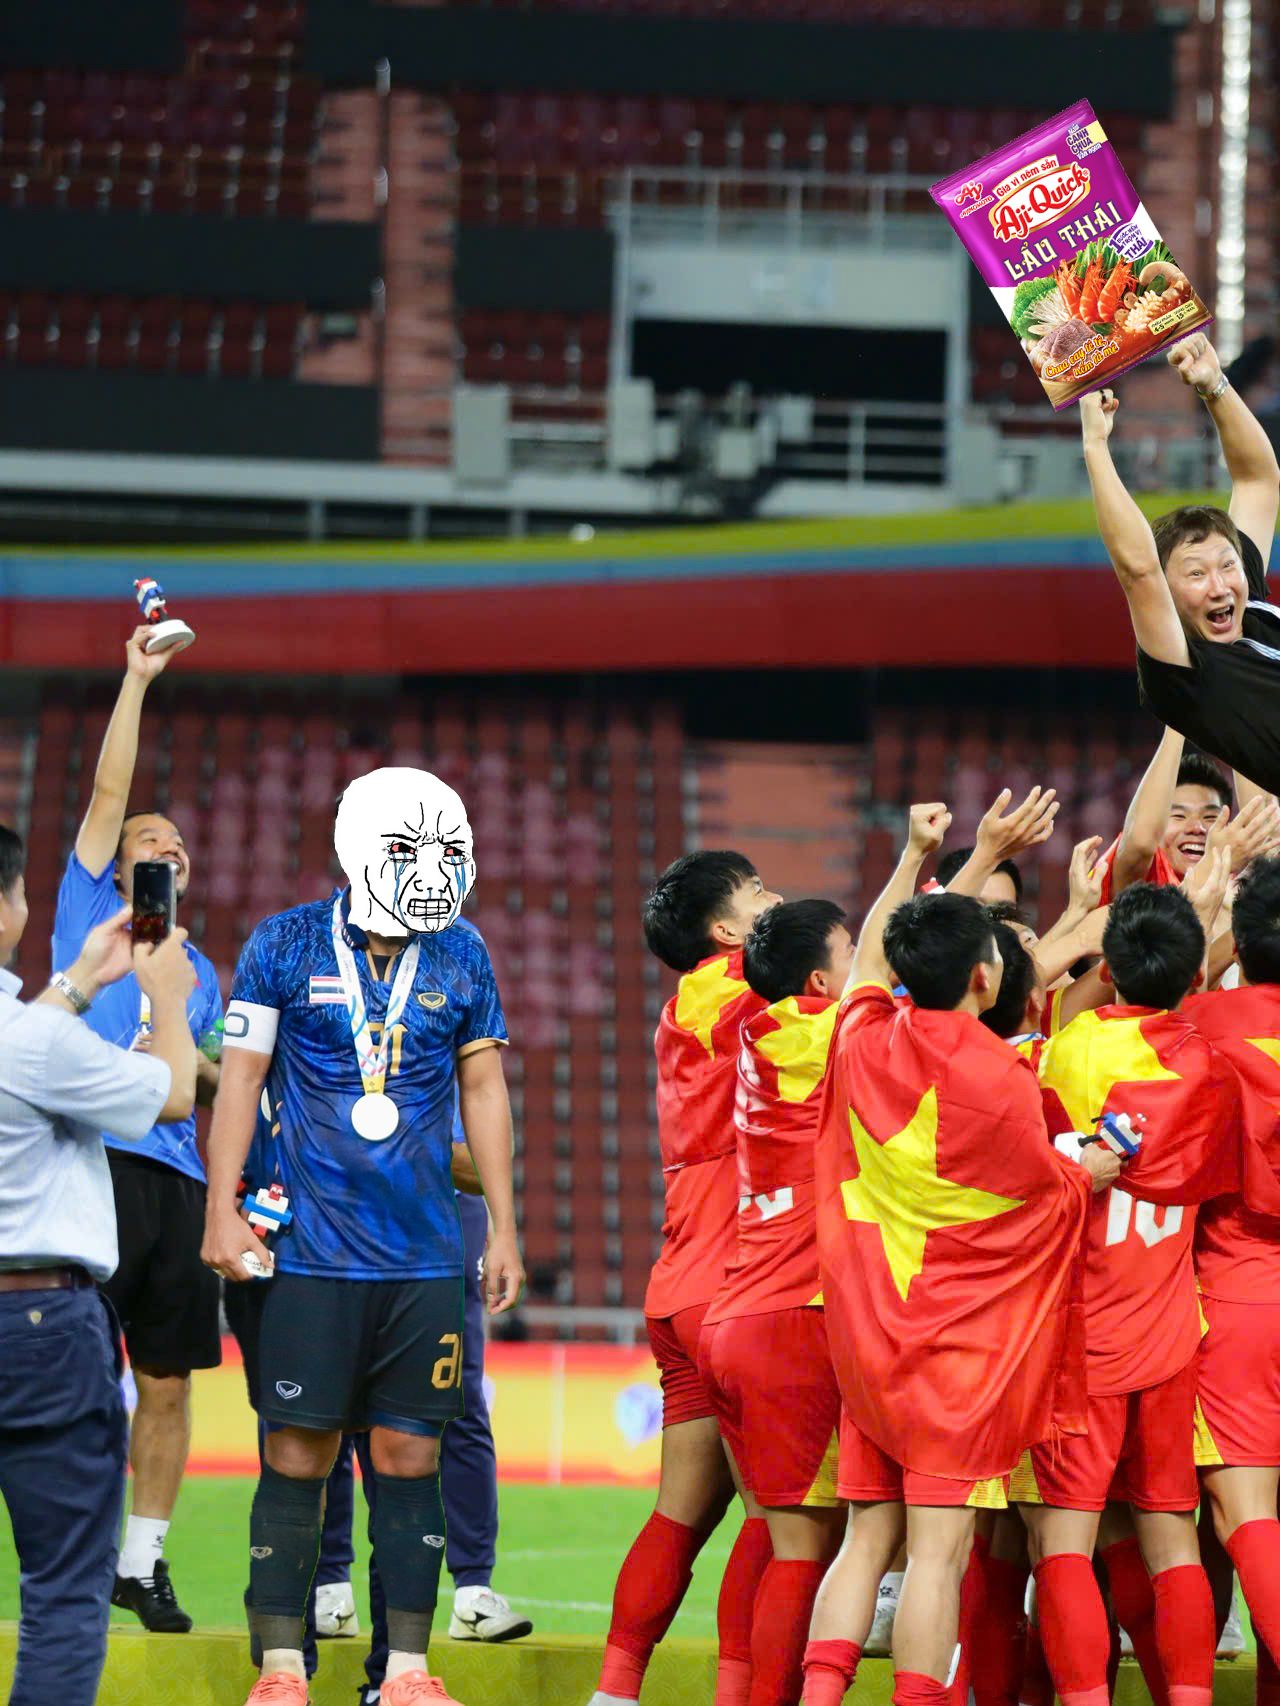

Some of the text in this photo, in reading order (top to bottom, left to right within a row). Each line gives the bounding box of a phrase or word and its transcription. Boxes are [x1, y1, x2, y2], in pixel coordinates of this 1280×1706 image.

[1067, 128, 1089, 145] CANH
[1071, 137, 1093, 154] CHUA
[996, 184, 1011, 197] Gia
[1020, 168, 1040, 182] nêm
[996, 162, 1088, 241] Aji-Quick
[1004, 201, 1123, 281] LẨU THÁI
[1124, 236, 1148, 258] THÁI
